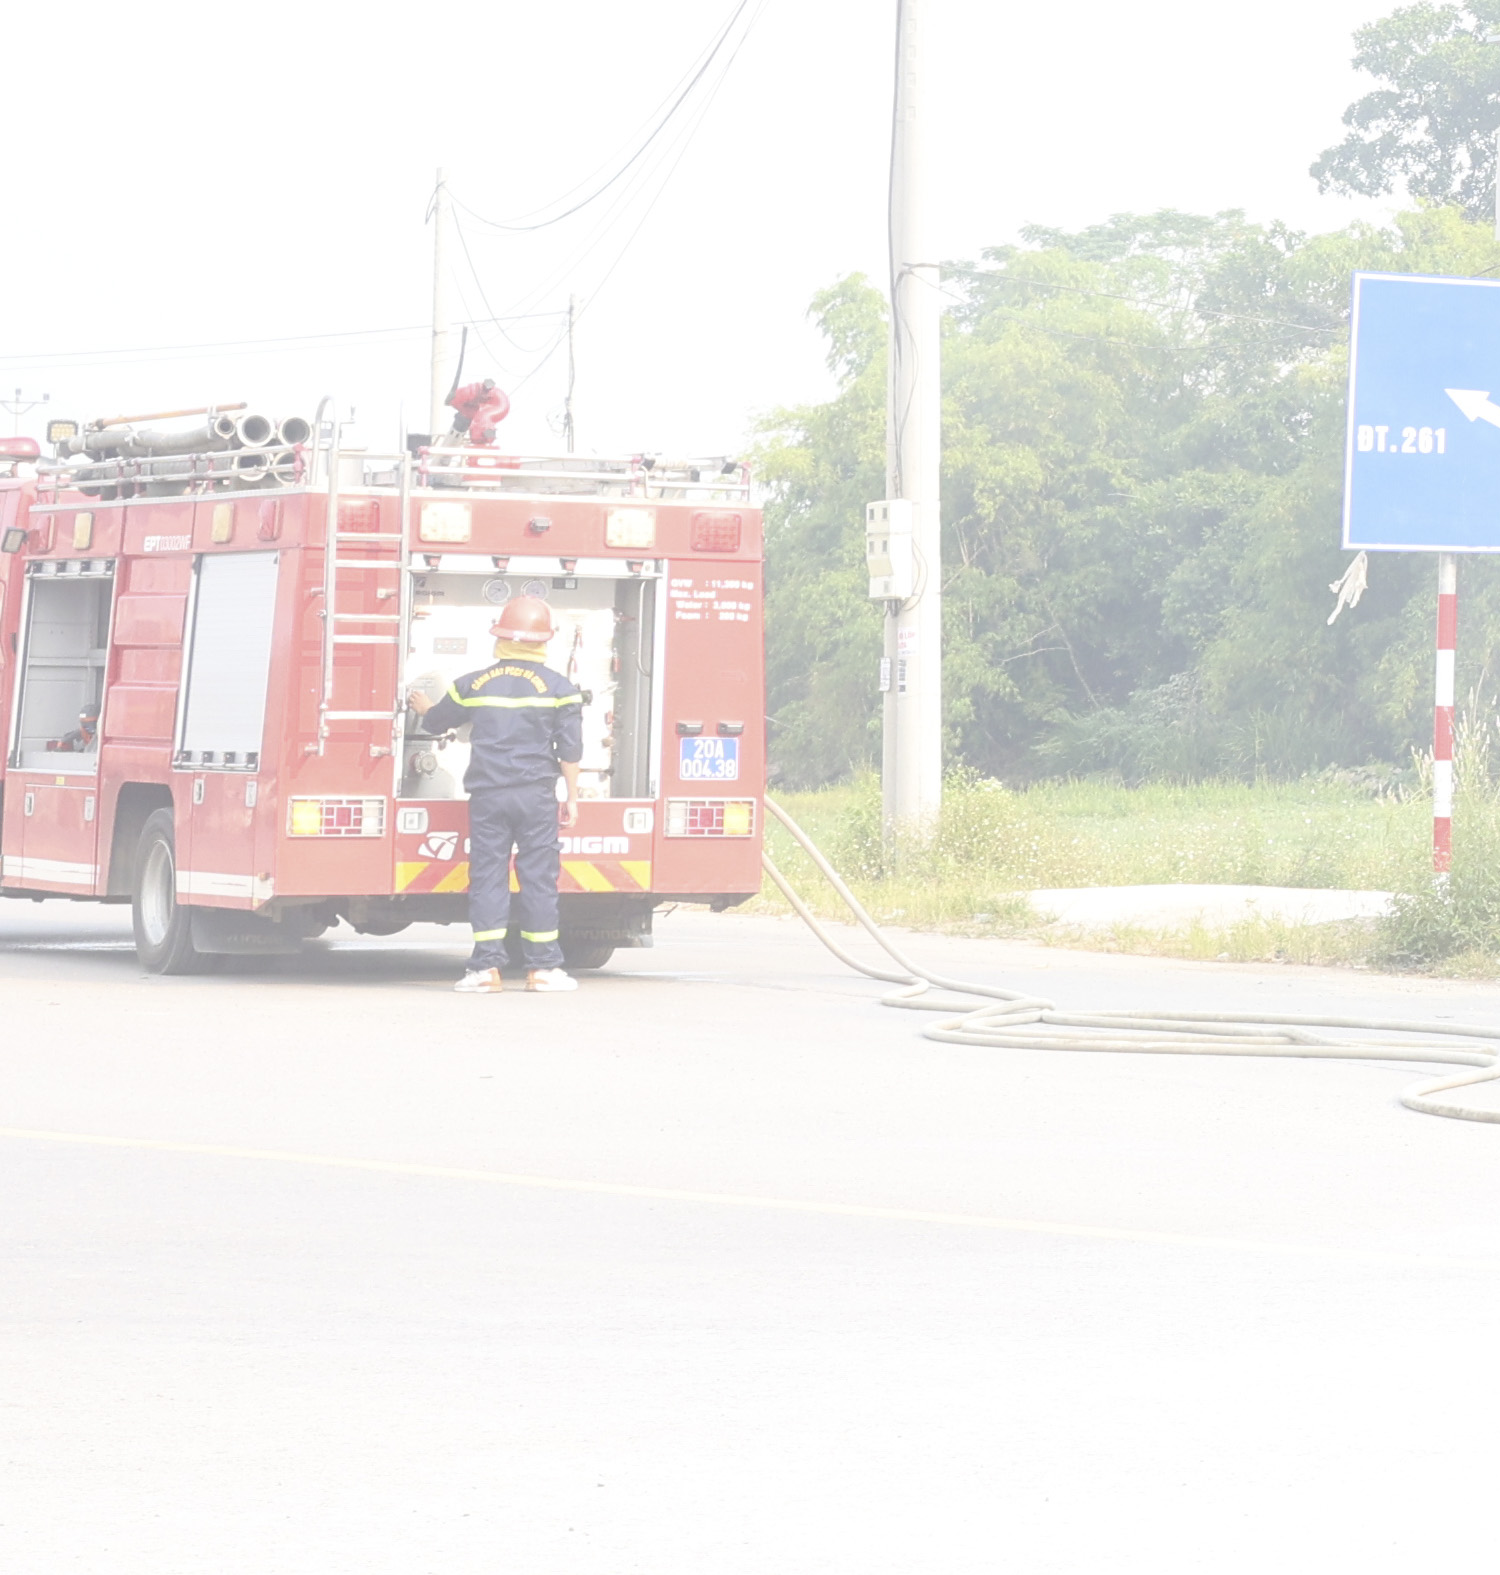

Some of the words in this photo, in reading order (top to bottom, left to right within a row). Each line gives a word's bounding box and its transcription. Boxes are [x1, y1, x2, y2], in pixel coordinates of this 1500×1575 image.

[1356, 425, 1446, 454] ĐT.261
[675, 600, 703, 609] Water
[675, 611, 701, 620] Foam
[693, 739, 725, 759] 20A
[681, 758, 737, 778] 004.38
